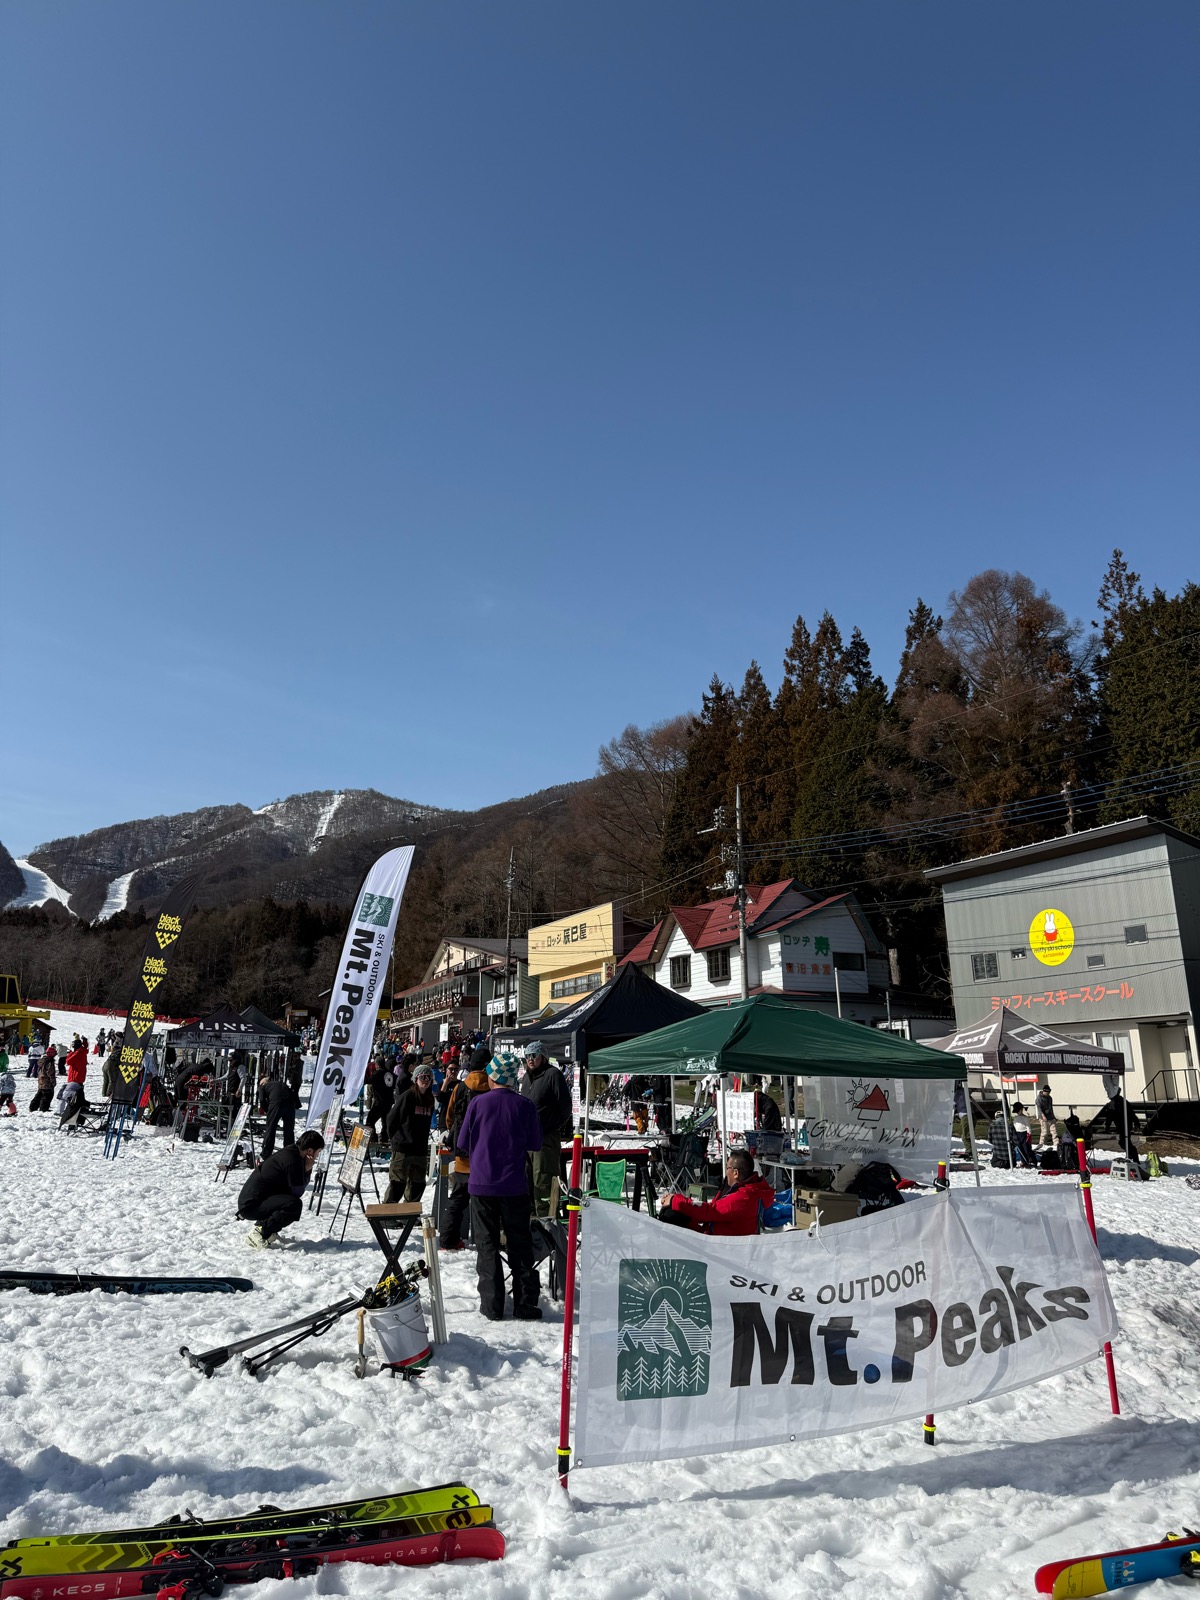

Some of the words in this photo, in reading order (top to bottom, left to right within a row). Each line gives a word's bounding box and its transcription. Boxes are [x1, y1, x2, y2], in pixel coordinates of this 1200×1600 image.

[159, 913, 181, 925] black
[157, 922, 182, 933] crows
[376, 933, 386, 950] SKI
[144, 956, 166, 967] black
[142, 965, 168, 975] crows
[365, 959, 381, 1006] OUTDOOR
[991, 982, 1135, 1010] ミッフィースキースクール
[132, 1000, 153, 1012] black
[131, 1009, 155, 1019] crows
[121, 1045, 144, 1057] black
[120, 1054, 143, 1065] crow
[1004, 1052, 1028, 1064] ROCKY
[1028, 1053, 1062, 1065] MOUNTAIN
[1063, 1054, 1110, 1068] UNDERGROUND
[878, 1127, 920, 1148] WAX
[729, 1274, 779, 1297] SKI
[786, 1286, 806, 1303] &
[816, 1260, 927, 1305] OUTDOOR
[729, 1301, 881, 1388] Mt.
[891, 1265, 1091, 1384] Peaks
[384, 1543, 462, 1559] OGASAA
[1114, 1561, 1122, 1584] LINE
[52, 1583, 106, 1597] KEOS
